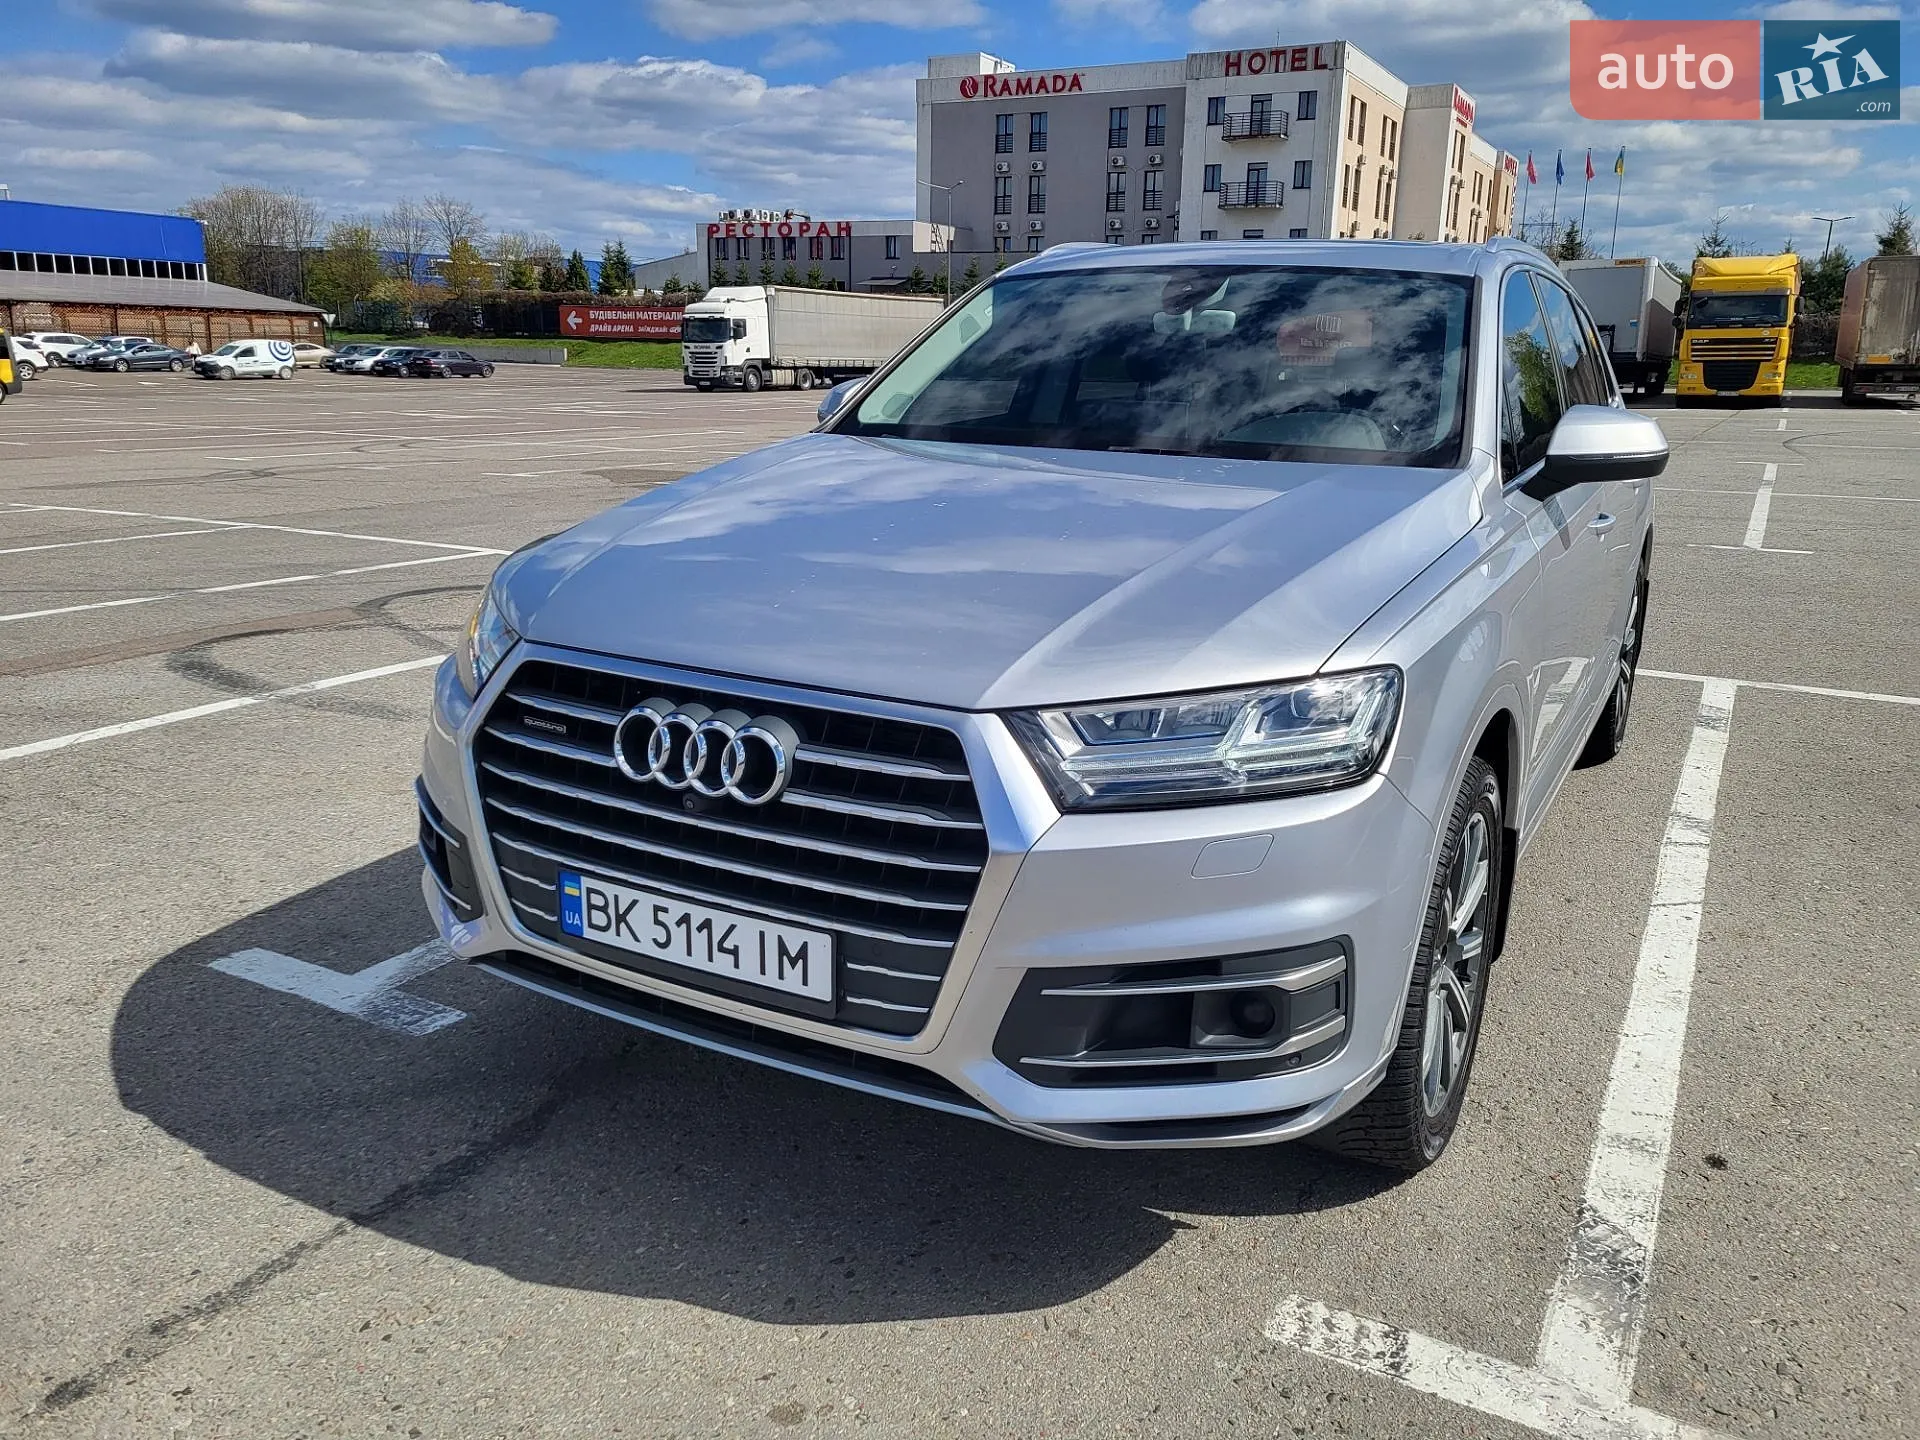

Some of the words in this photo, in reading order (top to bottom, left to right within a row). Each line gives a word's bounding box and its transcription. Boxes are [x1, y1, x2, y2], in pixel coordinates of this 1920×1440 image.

[1225, 46, 1329, 76] HOTEL
[983, 73, 1083, 98] RAMADA
[708, 221, 852, 238] РЕСТОРАН
[589, 310, 636, 320] БУДІВЕЛЬНІ
[636, 311, 683, 321] МАТЕРІАЛИ
[612, 324, 634, 333] АРЕНА
[523, 717, 564, 734] quattro
[565, 911, 582, 926] UA
[585, 887, 640, 944] BK
[652, 905, 741, 969] 5114
[759, 930, 809, 988] IM
